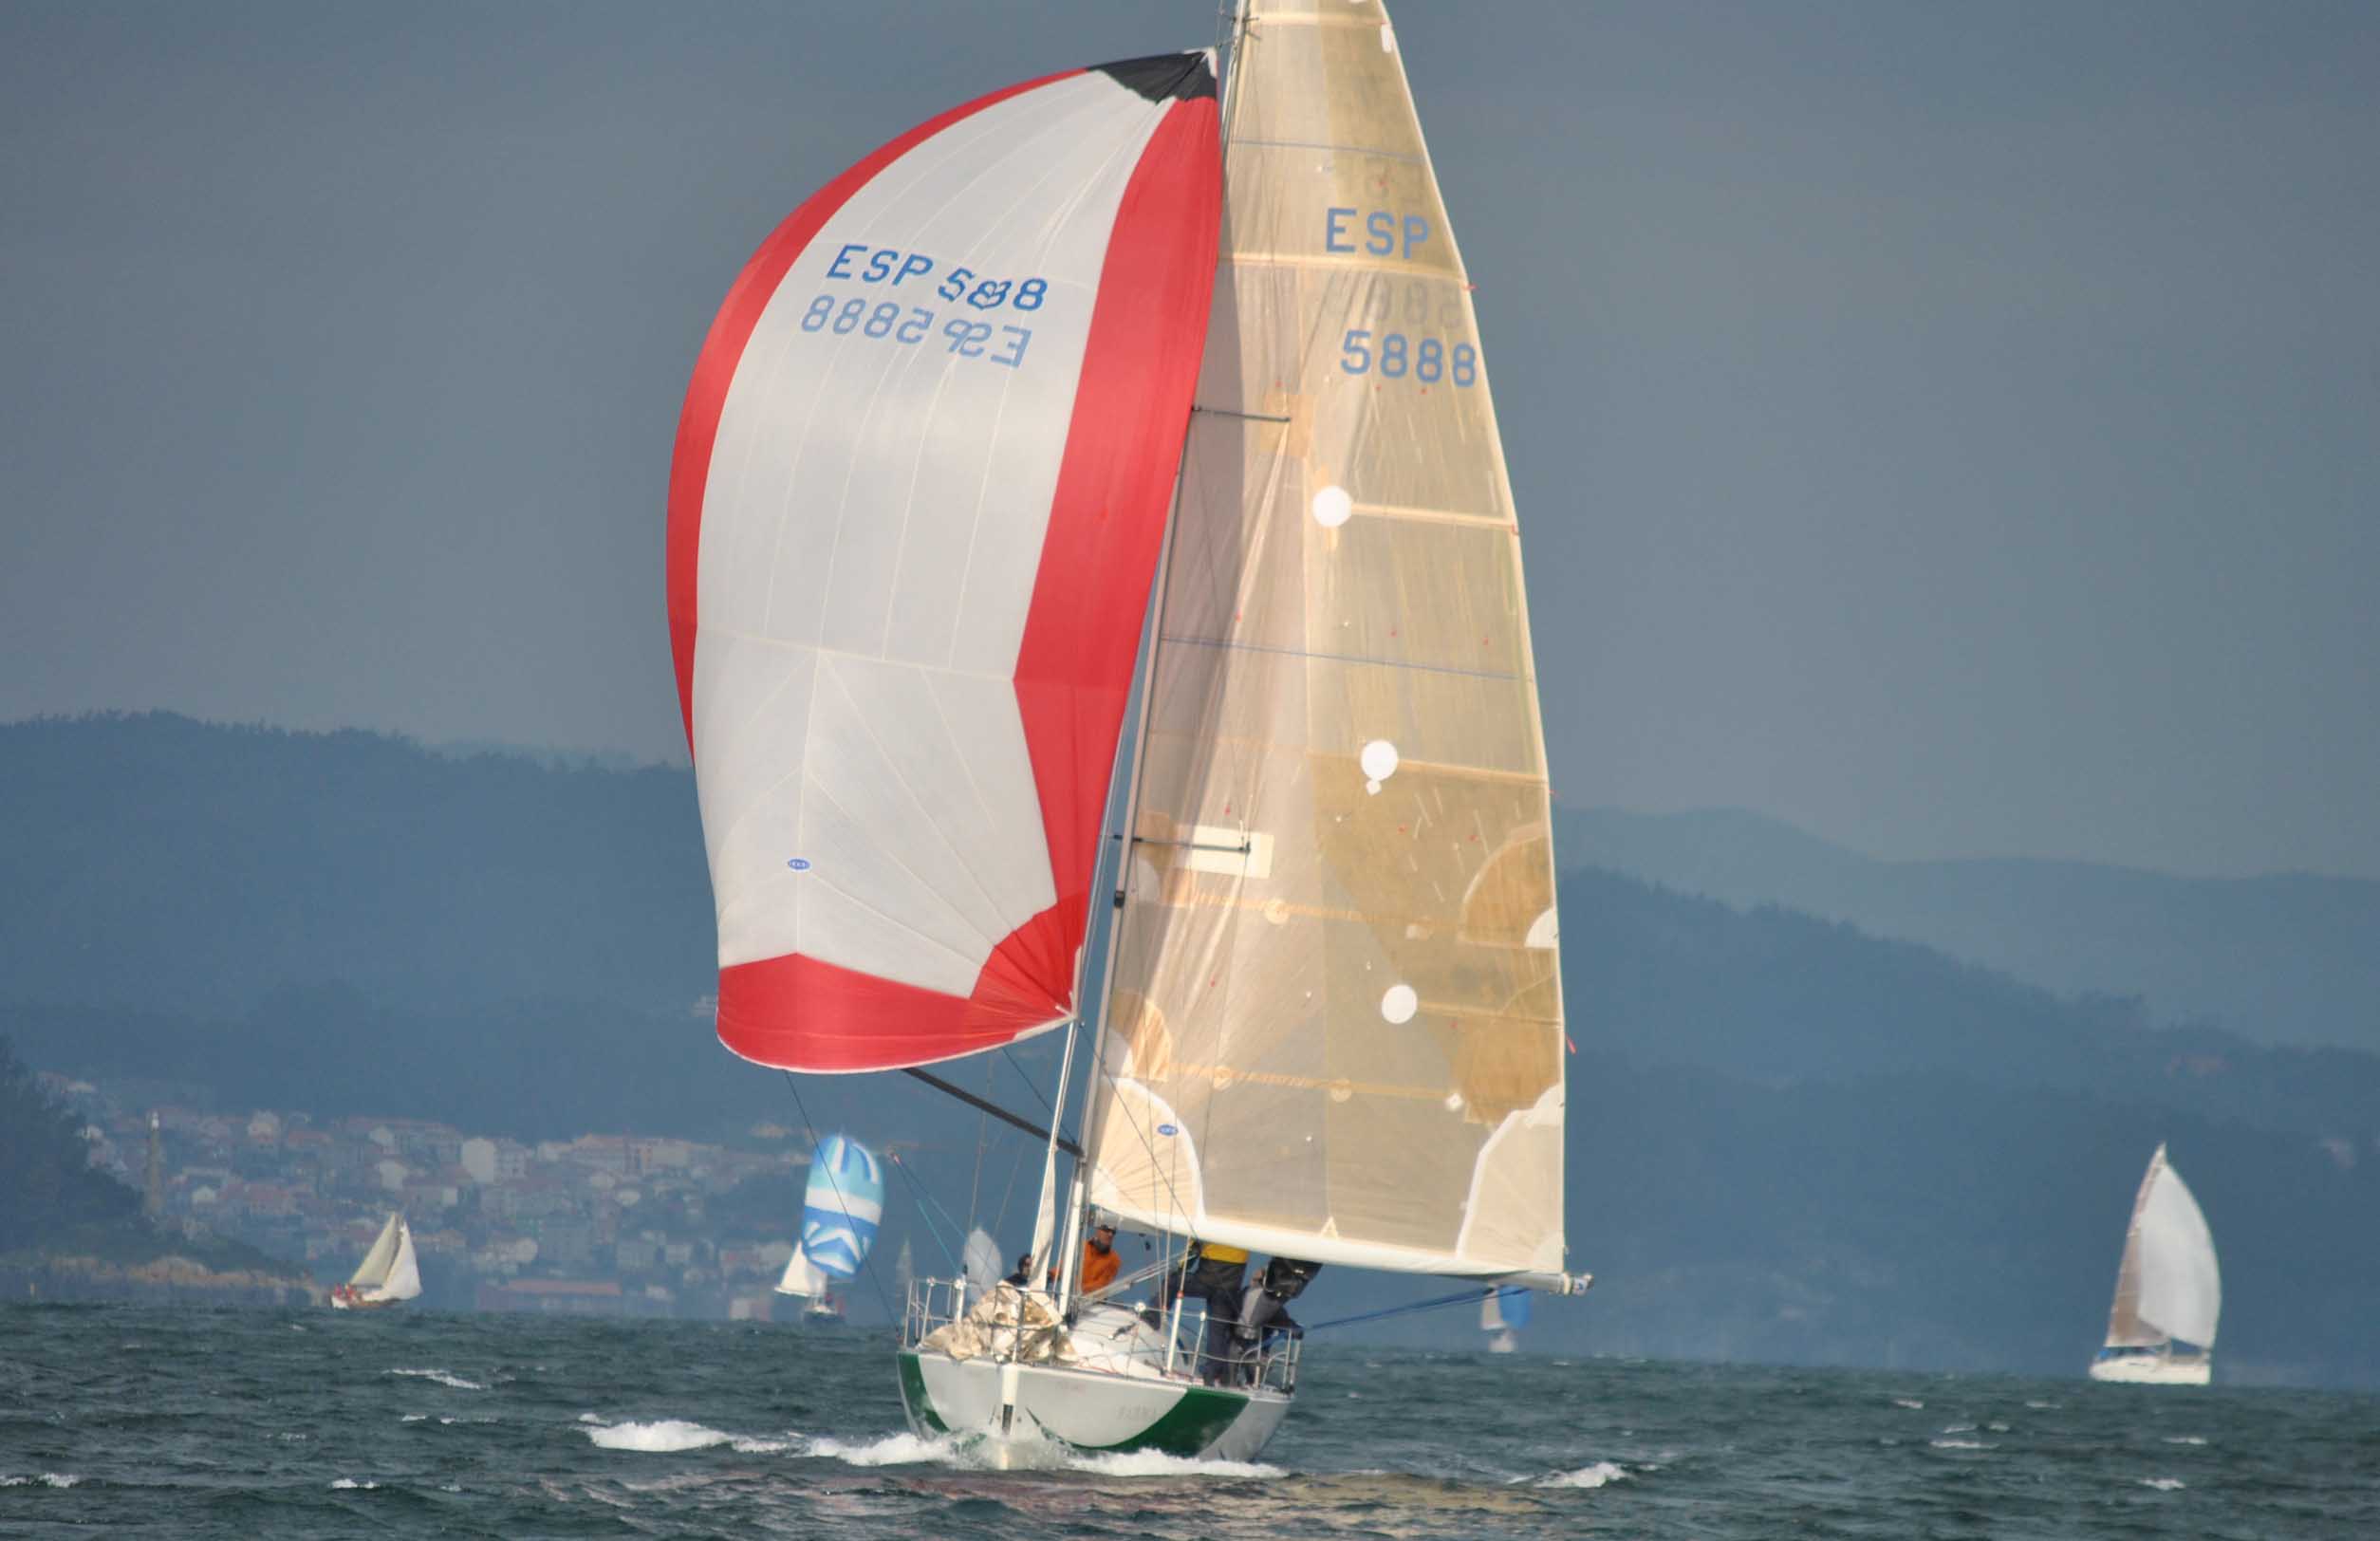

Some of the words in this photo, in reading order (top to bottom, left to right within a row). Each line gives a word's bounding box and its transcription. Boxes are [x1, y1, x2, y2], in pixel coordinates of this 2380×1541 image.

[1326, 207, 1431, 259] ESP
[826, 244, 934, 286] ESP
[1340, 329, 1476, 387] 5888
